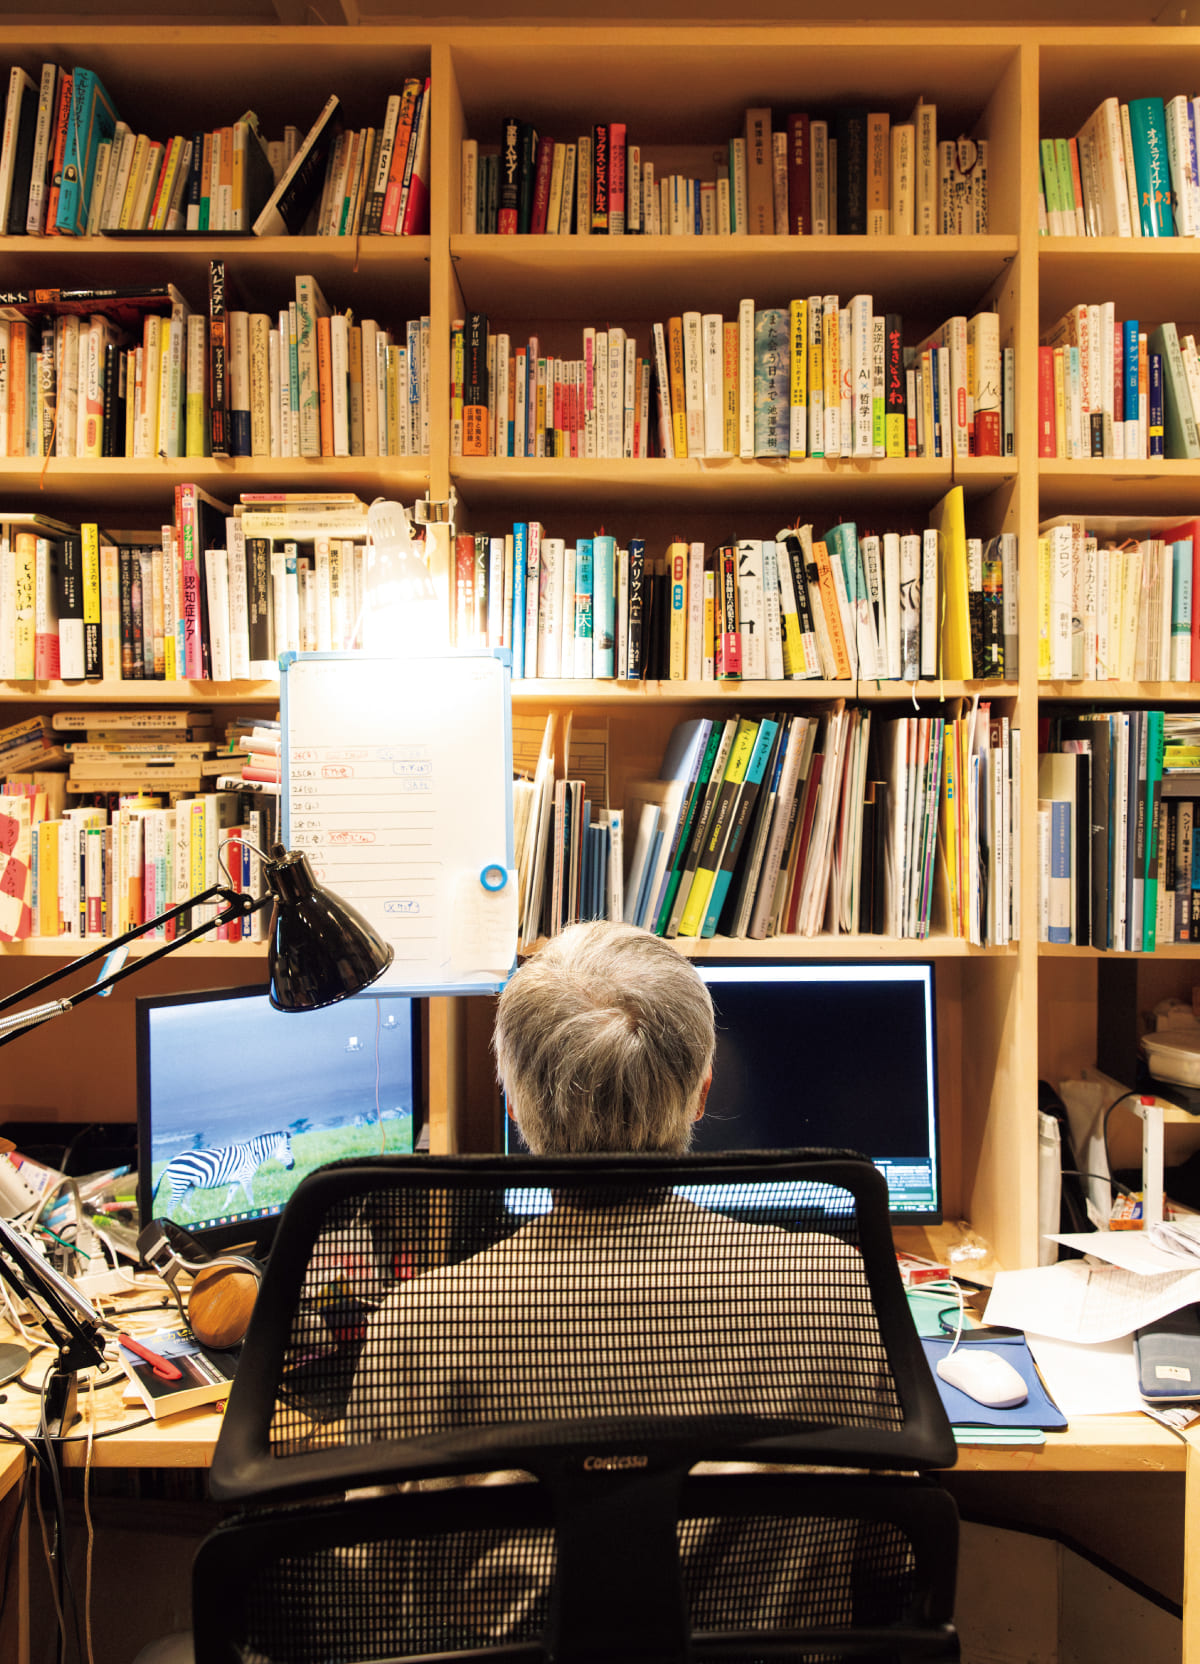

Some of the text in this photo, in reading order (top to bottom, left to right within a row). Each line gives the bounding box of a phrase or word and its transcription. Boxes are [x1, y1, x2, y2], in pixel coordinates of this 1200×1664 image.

[210, 262, 224, 314] パレスチナ
[472, 315, 481, 346] ガザ日記
[709, 320, 717, 355] 部分と全体
[873, 322, 883, 387] 反逆の仕事論
[611, 348, 620, 409] 口笛のはなし
[767, 314, 779, 447] また会う日まで 池澤夏樹
[474, 535, 489, 569] 叩く
[815, 562, 831, 589] 歩く
[183, 574, 197, 642] 認知症ケア
[5, 798, 16, 899] デモクラシーのいろは
